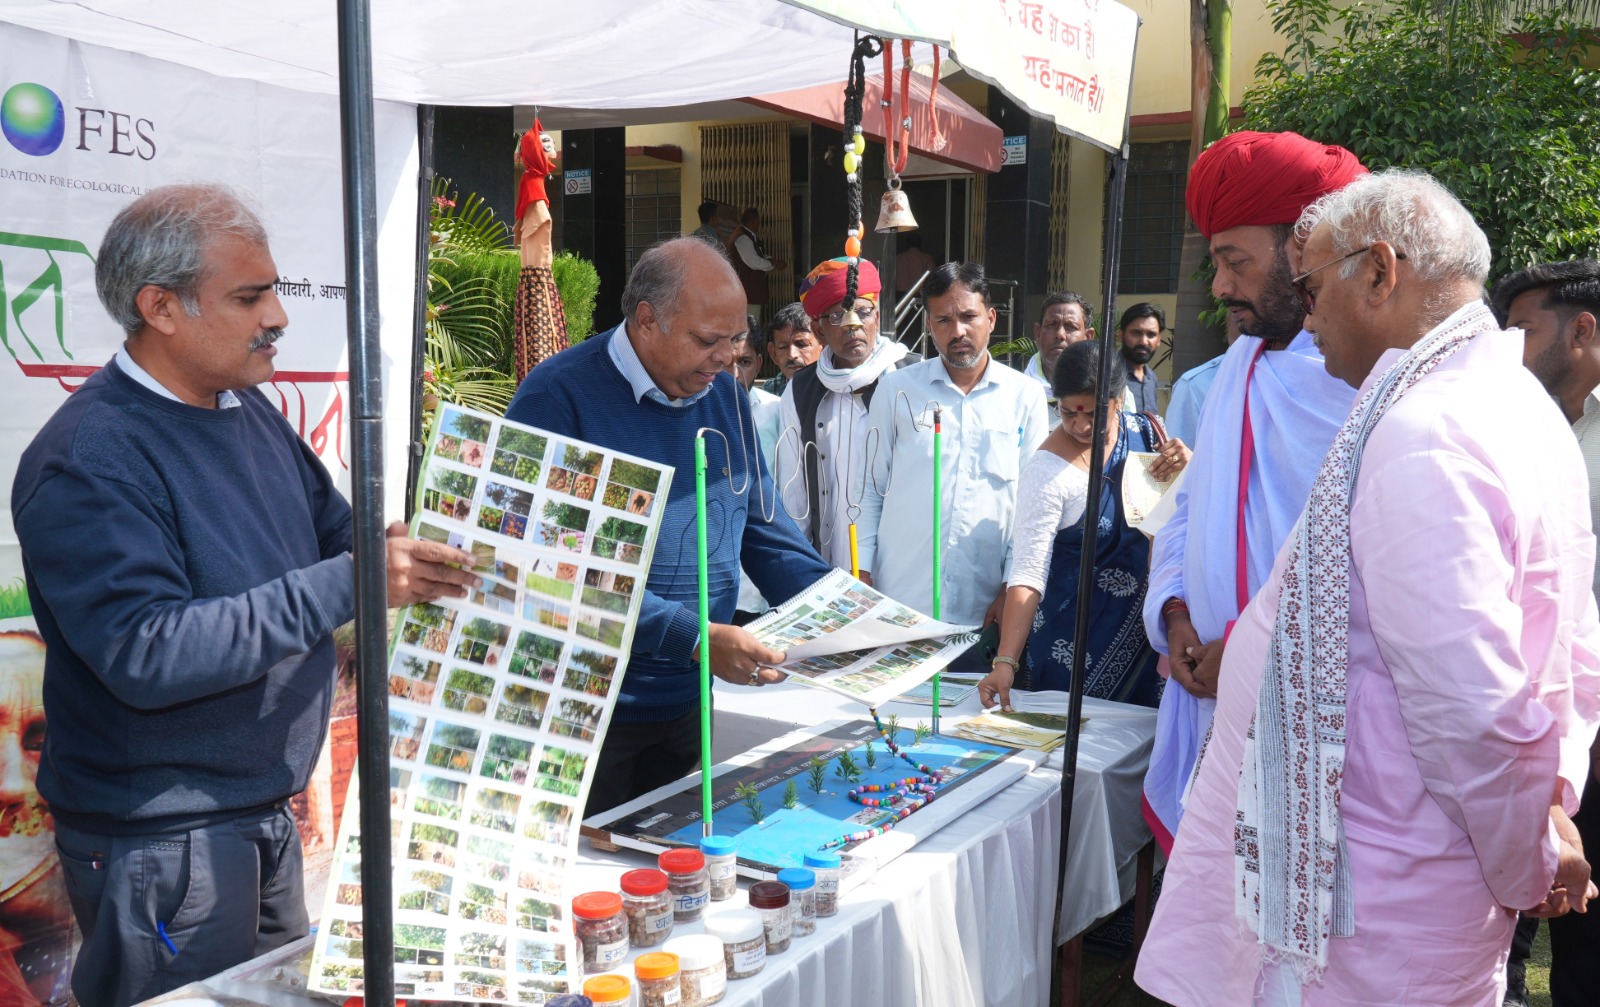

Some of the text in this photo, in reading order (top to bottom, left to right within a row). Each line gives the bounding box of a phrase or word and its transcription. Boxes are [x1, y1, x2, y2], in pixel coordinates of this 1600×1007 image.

[1061, 21, 1081, 51] का
[1021, 55, 1050, 88] यह
[75, 106, 157, 161] FES
[50, 175, 66, 188] FOR
[67, 179, 143, 196] ECOLOGICAL
